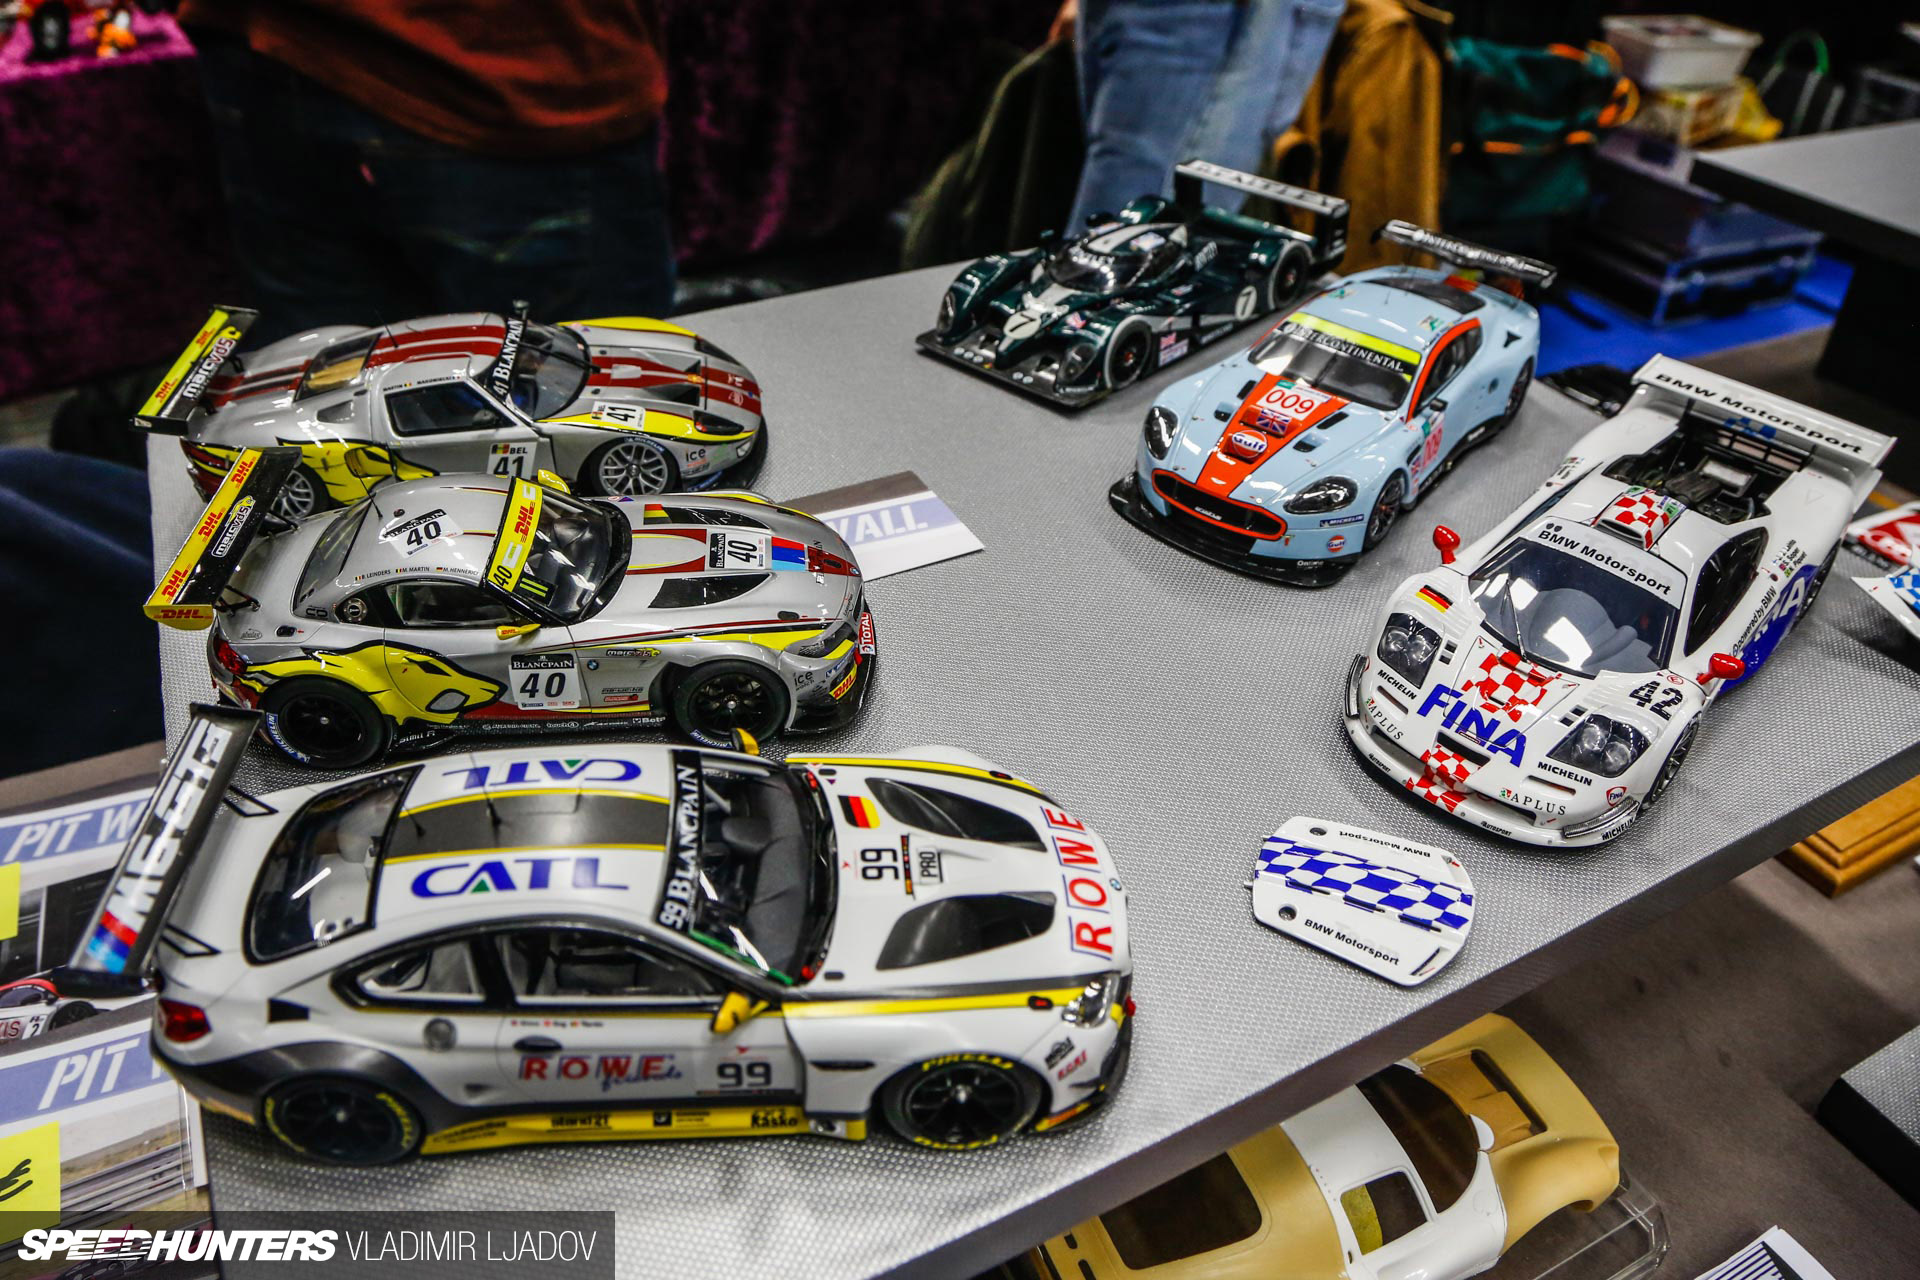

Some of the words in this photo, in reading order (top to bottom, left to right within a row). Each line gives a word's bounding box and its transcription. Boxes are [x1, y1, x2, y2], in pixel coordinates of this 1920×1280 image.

[1009, 313, 1037, 333] 7
[493, 317, 523, 382] BLANCPAIN
[493, 382, 509, 397] 41
[1265, 389, 1315, 414] 009
[607, 406, 637, 422] 41
[1656, 373, 1717, 398] BMW
[1721, 397, 1865, 453] Motorsport
[509, 447, 528, 455] BEL
[685, 448, 706, 462] ice
[1233, 434, 1266, 450] Gulf
[230, 461, 254, 485] DHL
[493, 456, 525, 479] 41
[198, 512, 224, 538] DHL
[514, 502, 536, 538] DHL
[406, 521, 442, 546] 40
[715, 534, 725, 567] BLANCPAIN
[727, 540, 758, 563] 40
[1538, 530, 1580, 550] BMW
[1580, 545, 1672, 595] Motorsport
[162, 569, 189, 598] DHL
[366, 569, 391, 579] LEINDERS
[493, 565, 513, 587] 40
[160, 609, 204, 619] DHL
[1737, 613, 1758, 651] powered
[1761, 586, 1777, 610] BMW
[862, 614, 872, 646] TOTAL
[513, 660, 574, 669] BLANCPAIN
[520, 672, 566, 698] 40
[793, 671, 813, 687] ice
[834, 674, 853, 698] DHL
[1377, 669, 1417, 700] MICHELIN
[1629, 680, 1683, 721] 42
[267, 713, 297, 754] MICHELIN
[1417, 683, 1527, 768] FINA
[692, 732, 730, 748] MICHELIN
[442, 759, 642, 790] CATL
[1537, 761, 1592, 787] MICHELIN
[5, 812, 92, 863] PIT
[668, 765, 699, 901] BLANCPAIN
[1339, 830, 1401, 850] Motorsport
[1602, 817, 1635, 841] MICHELIN
[861, 848, 900, 880] 99
[919, 850, 939, 878] PRO
[1403, 846, 1431, 858] BMW
[411, 858, 629, 898] CATL
[1044, 807, 1113, 955] ROWE
[660, 901, 688, 930] 99
[1304, 918, 1334, 936] BMW
[1335, 931, 1400, 966] Motorsport
[38, 1033, 141, 1111] PIT
[519, 1054, 674, 1081] ROWE
[717, 1062, 773, 1089] 99
[922, 1053, 1014, 1072] PIRELLI
